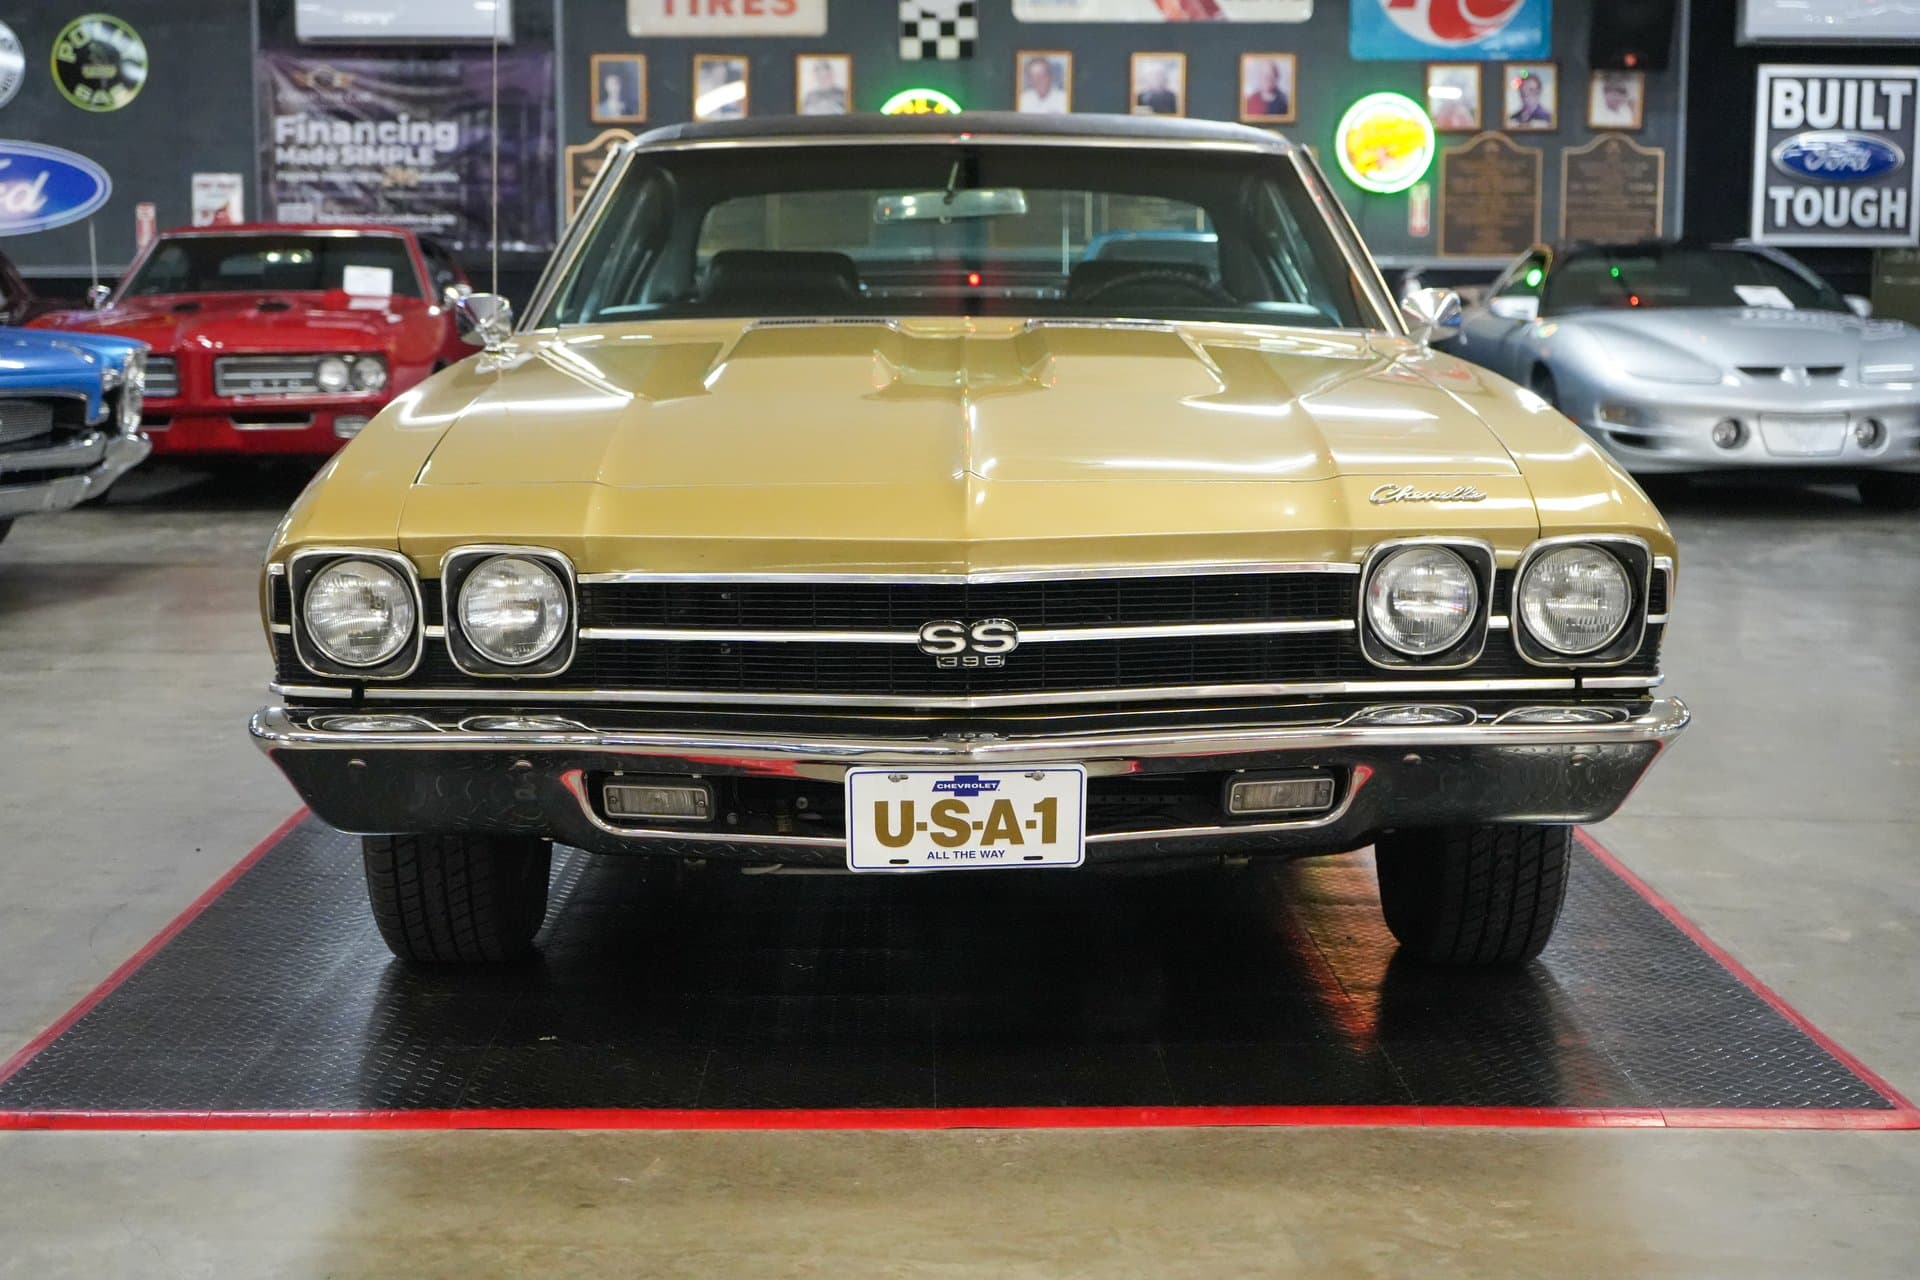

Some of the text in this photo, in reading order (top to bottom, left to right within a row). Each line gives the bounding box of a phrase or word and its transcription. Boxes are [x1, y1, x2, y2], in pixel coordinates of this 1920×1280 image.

[1771, 79, 1912, 130] BUILT
[274, 112, 459, 152] Financing
[275, 146, 338, 165] Made
[1804, 143, 1872, 172] Ford
[1768, 186, 1907, 228] TOUGH
[1369, 484, 1488, 505] Chevelle
[918, 619, 1019, 656] SS
[939, 655, 1004, 668] 396
[935, 782, 998, 790] CHEVROLET
[874, 797, 1058, 848] U-S-A-1
[927, 850, 1005, 860] ALL THE WAY
